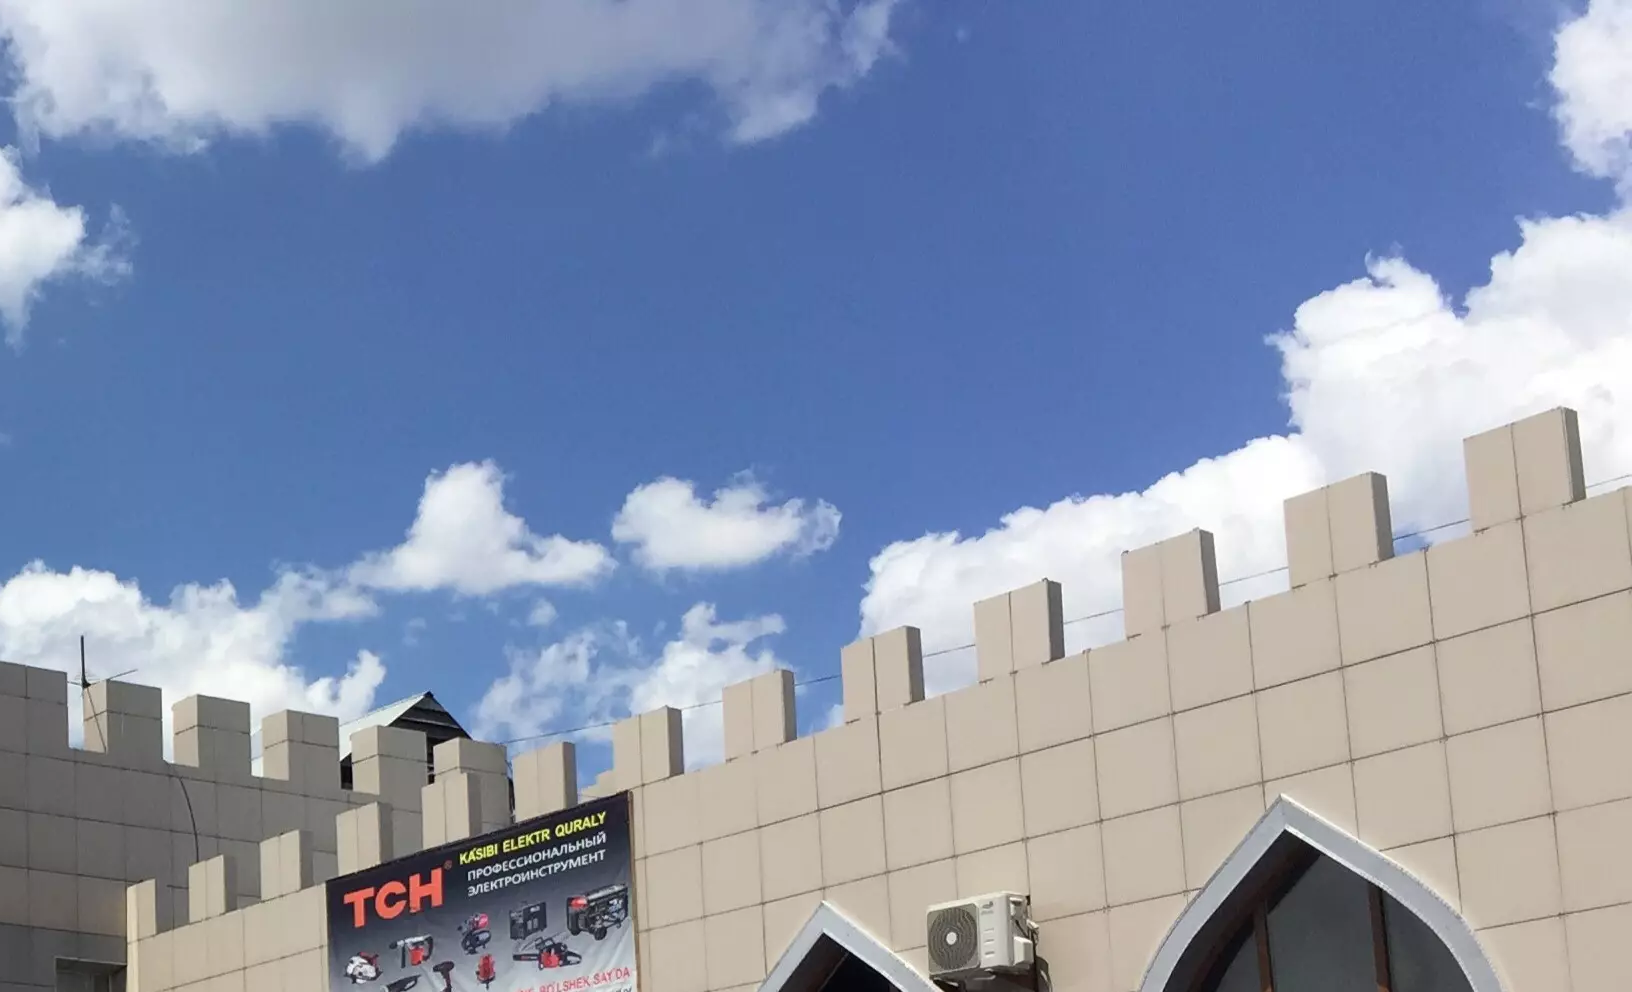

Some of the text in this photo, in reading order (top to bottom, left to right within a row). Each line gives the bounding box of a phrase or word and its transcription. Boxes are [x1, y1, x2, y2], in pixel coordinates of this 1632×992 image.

[467, 831, 607, 881] ПРОФЕССИОНАЛЬНЫЙ
[502, 828, 550, 853] ELEKTR
[555, 811, 607, 838] QURALY
[467, 849, 607, 897] ЭЛЕКТРОИНСТРУМЕНТ
[343, 867, 445, 929] TCH
